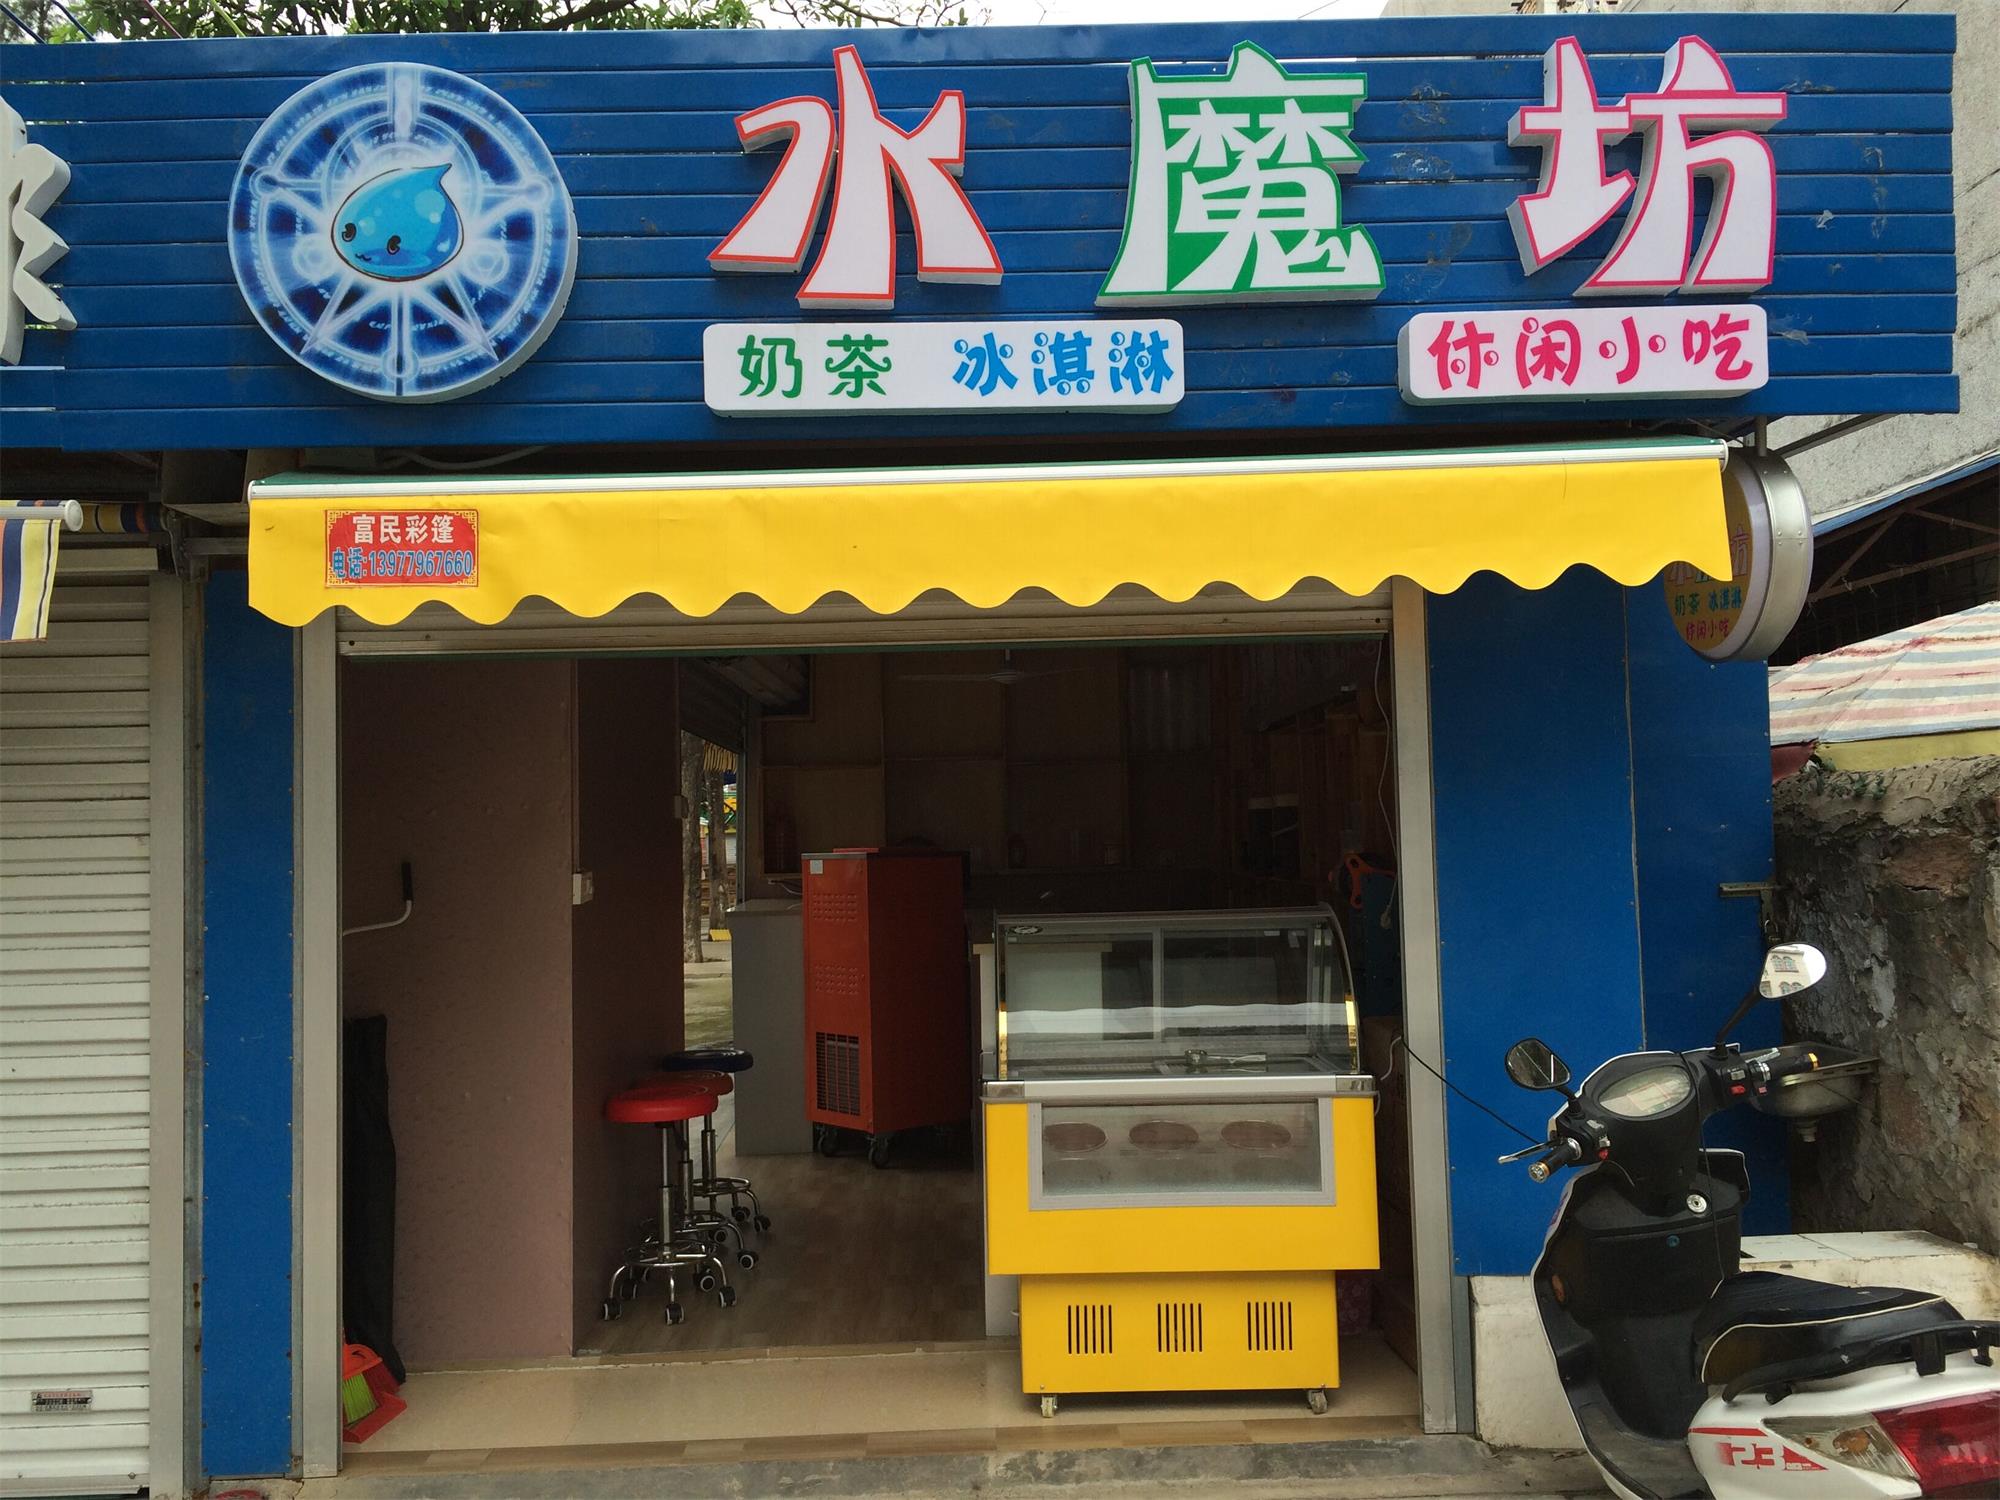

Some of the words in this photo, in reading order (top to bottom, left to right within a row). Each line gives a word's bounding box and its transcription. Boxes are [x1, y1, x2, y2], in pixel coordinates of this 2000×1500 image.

[707, 36, 1787, 309] 水魔坊
[737, 334, 892, 398] 奶茶
[953, 330, 1174, 397] 冰淇淋
[1427, 313, 1753, 390] 休闲小吃
